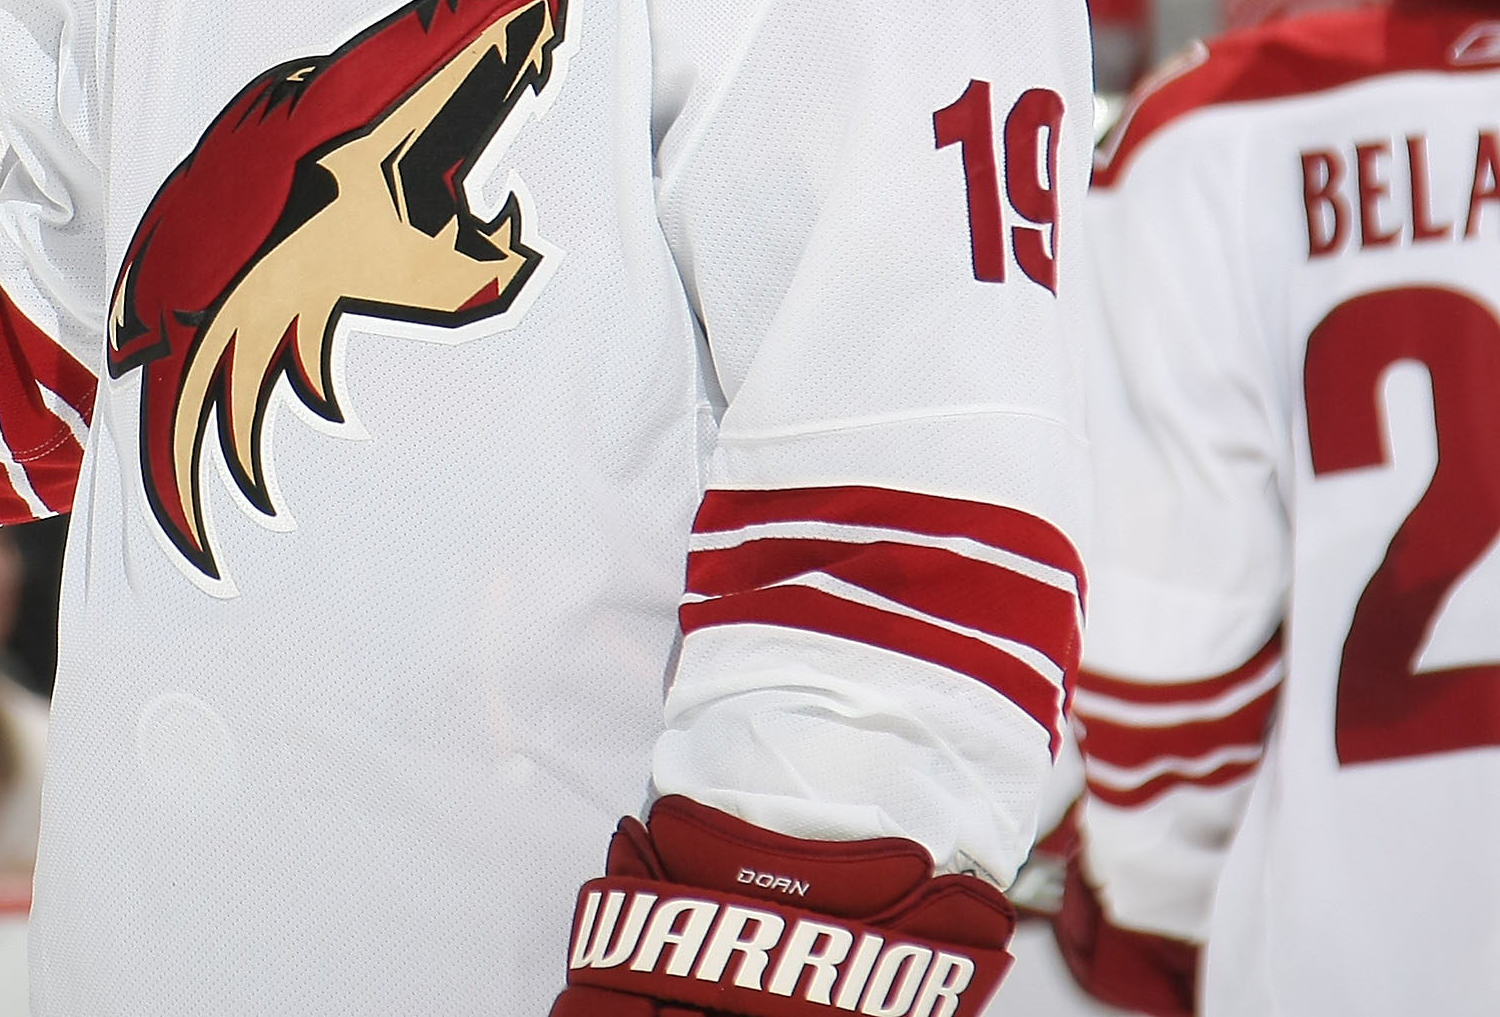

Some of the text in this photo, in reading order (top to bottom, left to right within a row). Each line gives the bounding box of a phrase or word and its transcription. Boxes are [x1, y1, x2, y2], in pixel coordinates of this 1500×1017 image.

[933, 78, 1065, 299] 19
[1303, 285, 1500, 766] 2
[570, 890, 975, 1017] WARRIOR
[738, 868, 810, 897] DOAN
